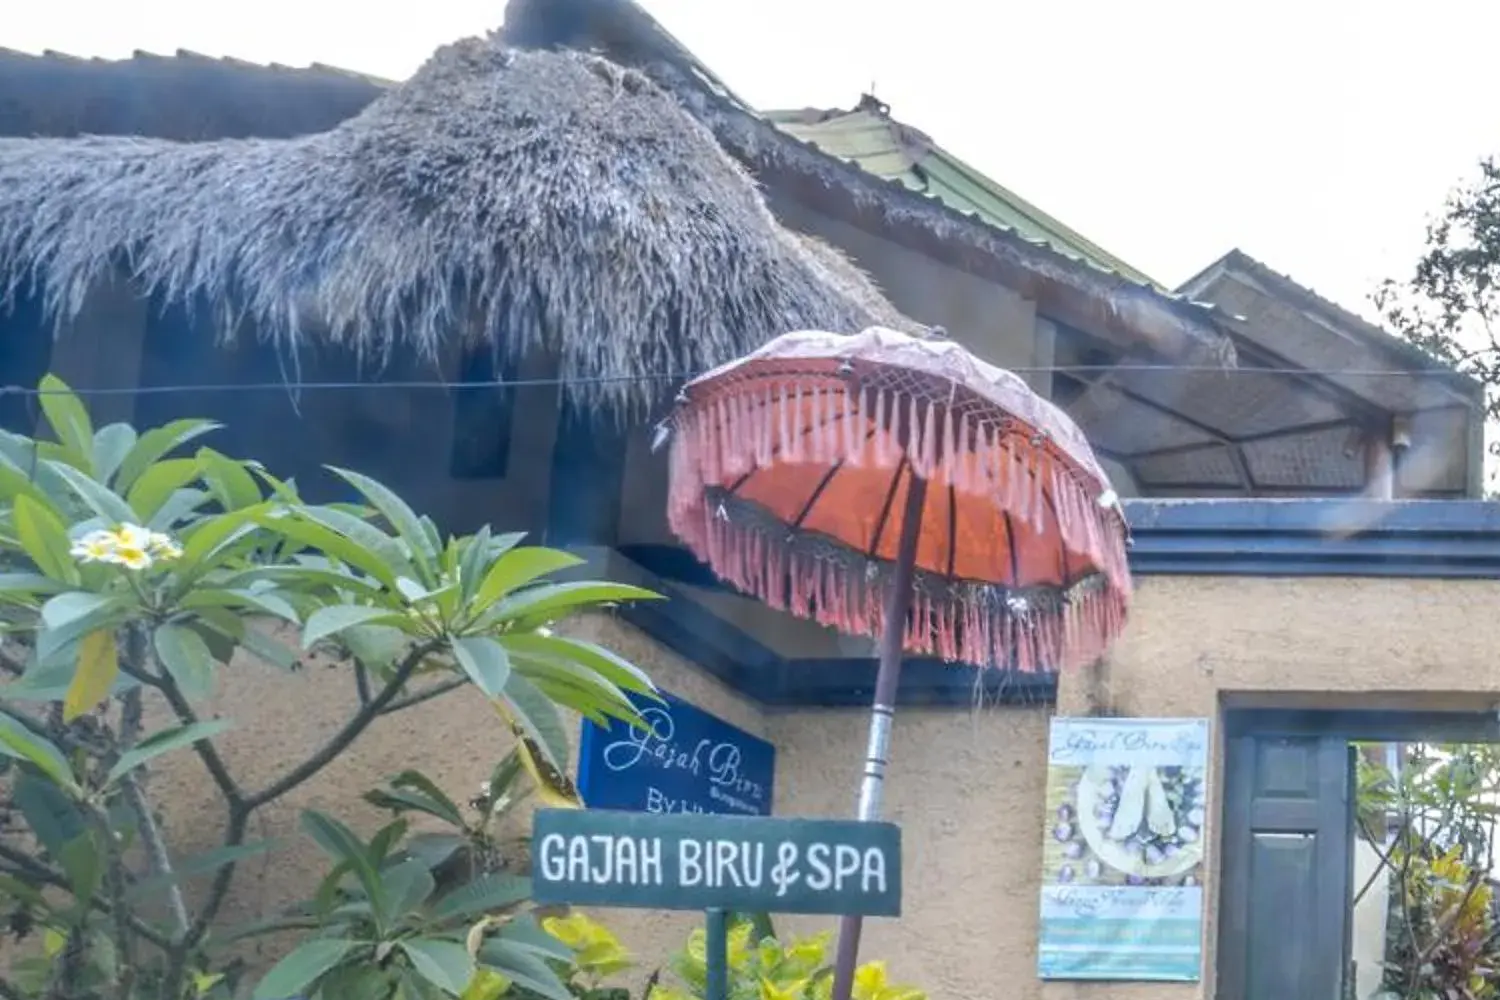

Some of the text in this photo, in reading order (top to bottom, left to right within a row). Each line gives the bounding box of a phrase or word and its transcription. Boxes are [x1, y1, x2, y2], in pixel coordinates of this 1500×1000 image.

[604, 707, 711, 776] Gajah
[540, 833, 887, 897] GAJAH BIRU & SPA
